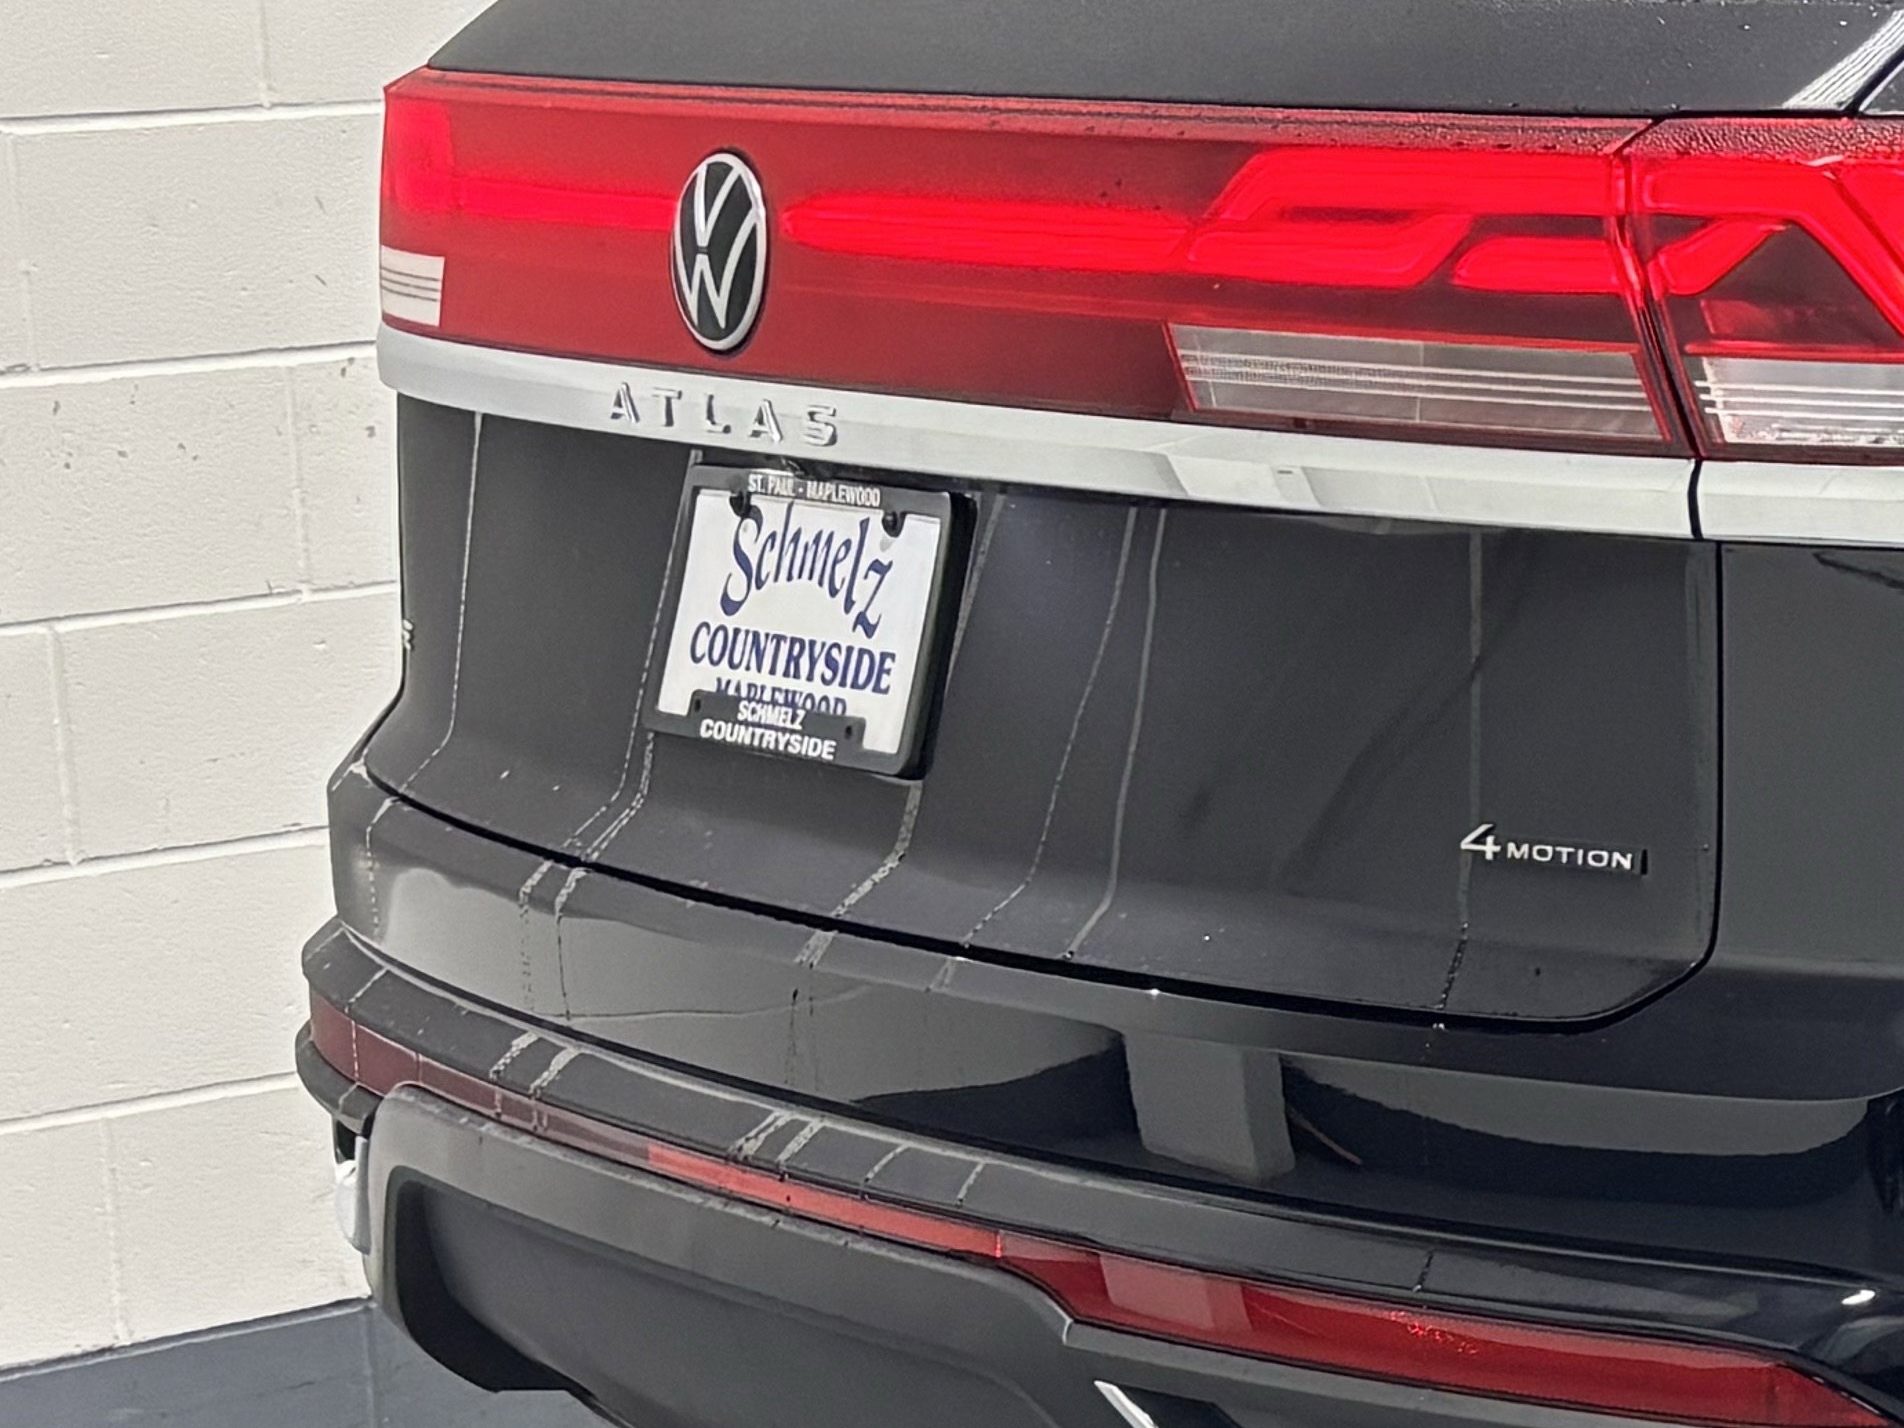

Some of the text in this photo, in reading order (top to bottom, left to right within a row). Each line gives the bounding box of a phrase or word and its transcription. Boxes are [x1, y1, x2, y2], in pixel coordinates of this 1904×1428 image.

[611, 382, 838, 448] ATLAS
[748, 474, 763, 493] ST.
[767, 475, 796, 497] PAUL
[807, 481, 881, 508] MAPLEWOOD
[720, 499, 893, 640] Schmelz
[690, 621, 896, 695] COUNTRYSIDE
[737, 700, 806, 730] SCHMELZ
[700, 718, 837, 761] COUNTRYSIDE
[1460, 823, 1633, 870] 4MOTION
